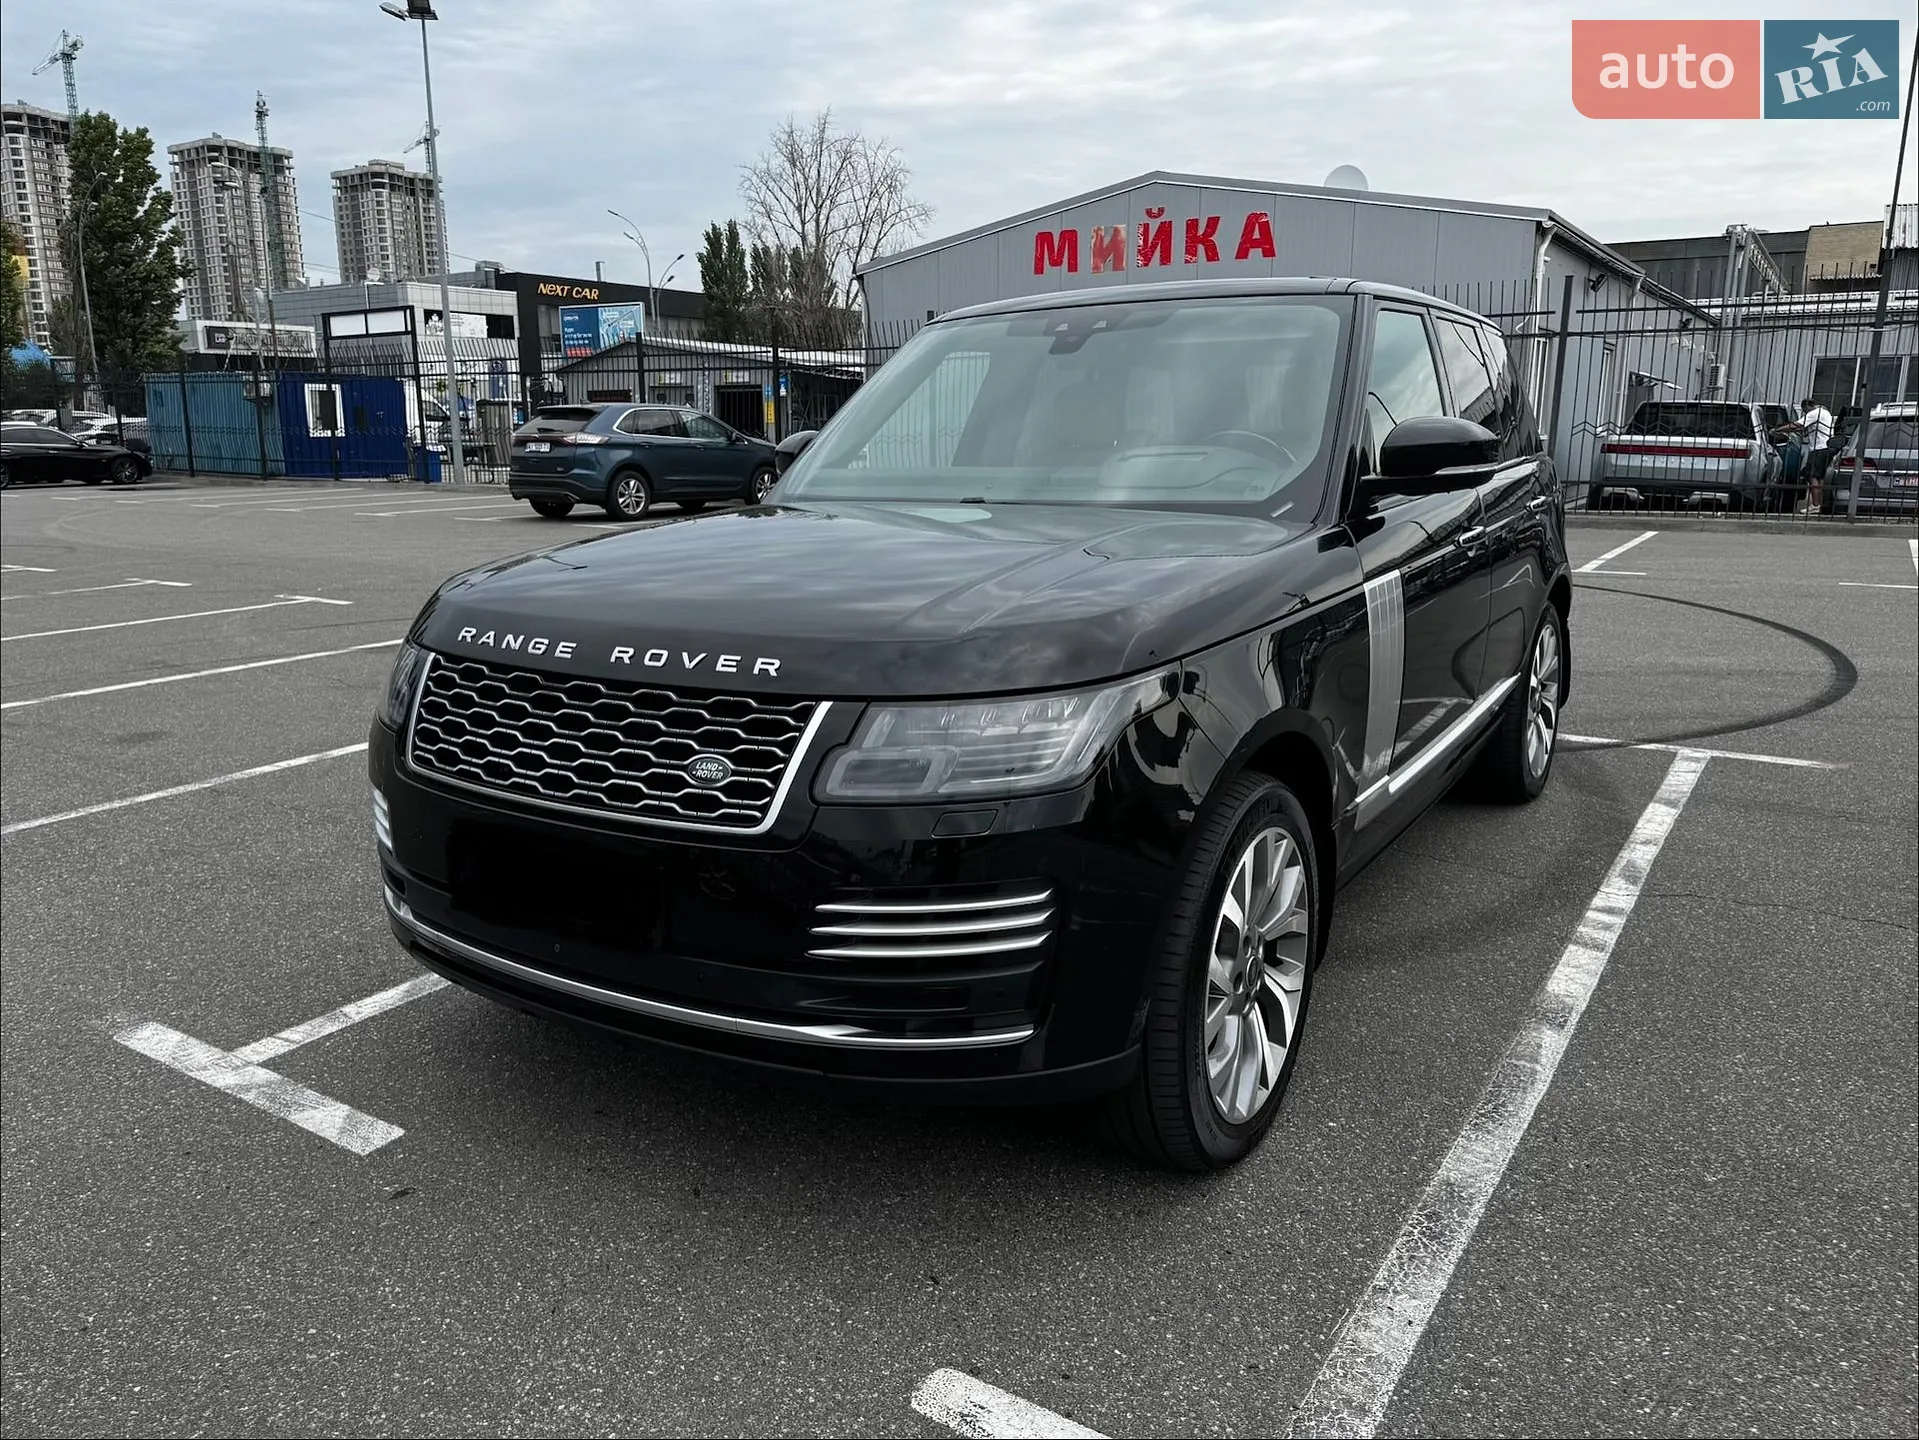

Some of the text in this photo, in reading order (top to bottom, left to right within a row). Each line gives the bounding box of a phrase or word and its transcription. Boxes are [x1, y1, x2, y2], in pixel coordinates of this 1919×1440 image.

[1033, 206, 1277, 275] МИЙКА
[572, 287, 599, 300] CAR
[457, 626, 782, 677] RANGE ROVER
